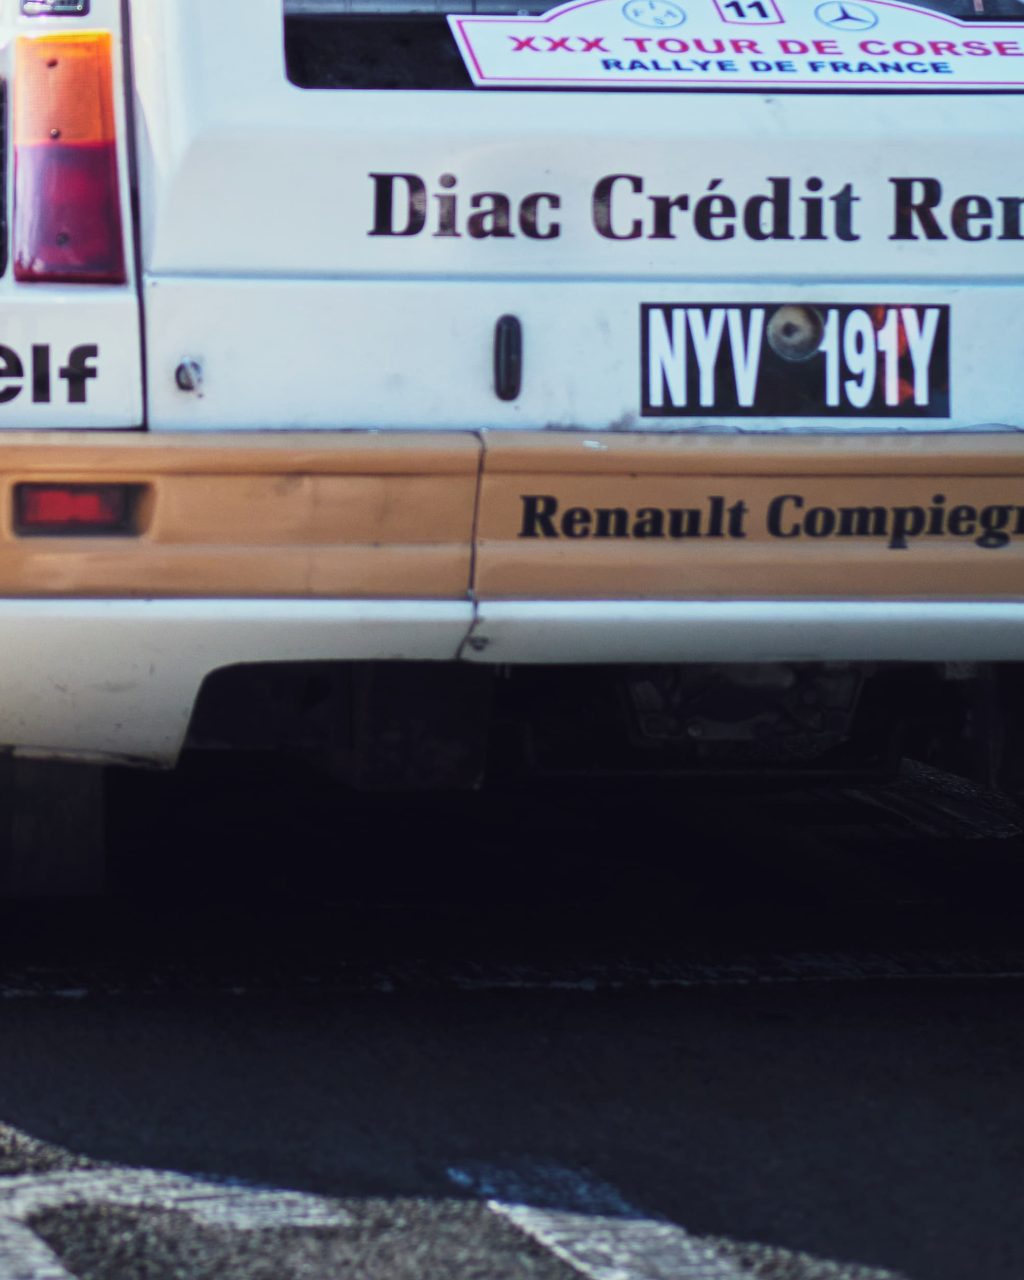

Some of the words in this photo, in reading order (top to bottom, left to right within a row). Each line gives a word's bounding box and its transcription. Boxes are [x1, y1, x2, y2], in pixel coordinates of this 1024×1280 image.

[725, 0, 769, 19] 11
[507, 36, 611, 53] XXX
[623, 37, 763, 55] TOUR
[777, 39, 844, 56] DE
[859, 41, 1024, 57] CORSE
[600, 58, 739, 72] RALLYE
[750, 60, 798, 73] DE
[808, 61, 954, 74] FRANCE
[366, 172, 562, 240] Diac
[592, 173, 861, 242] Crédit
[648, 307, 765, 408] NYV
[818, 307, 941, 408] 191Y
[517, 494, 749, 538] Renault
